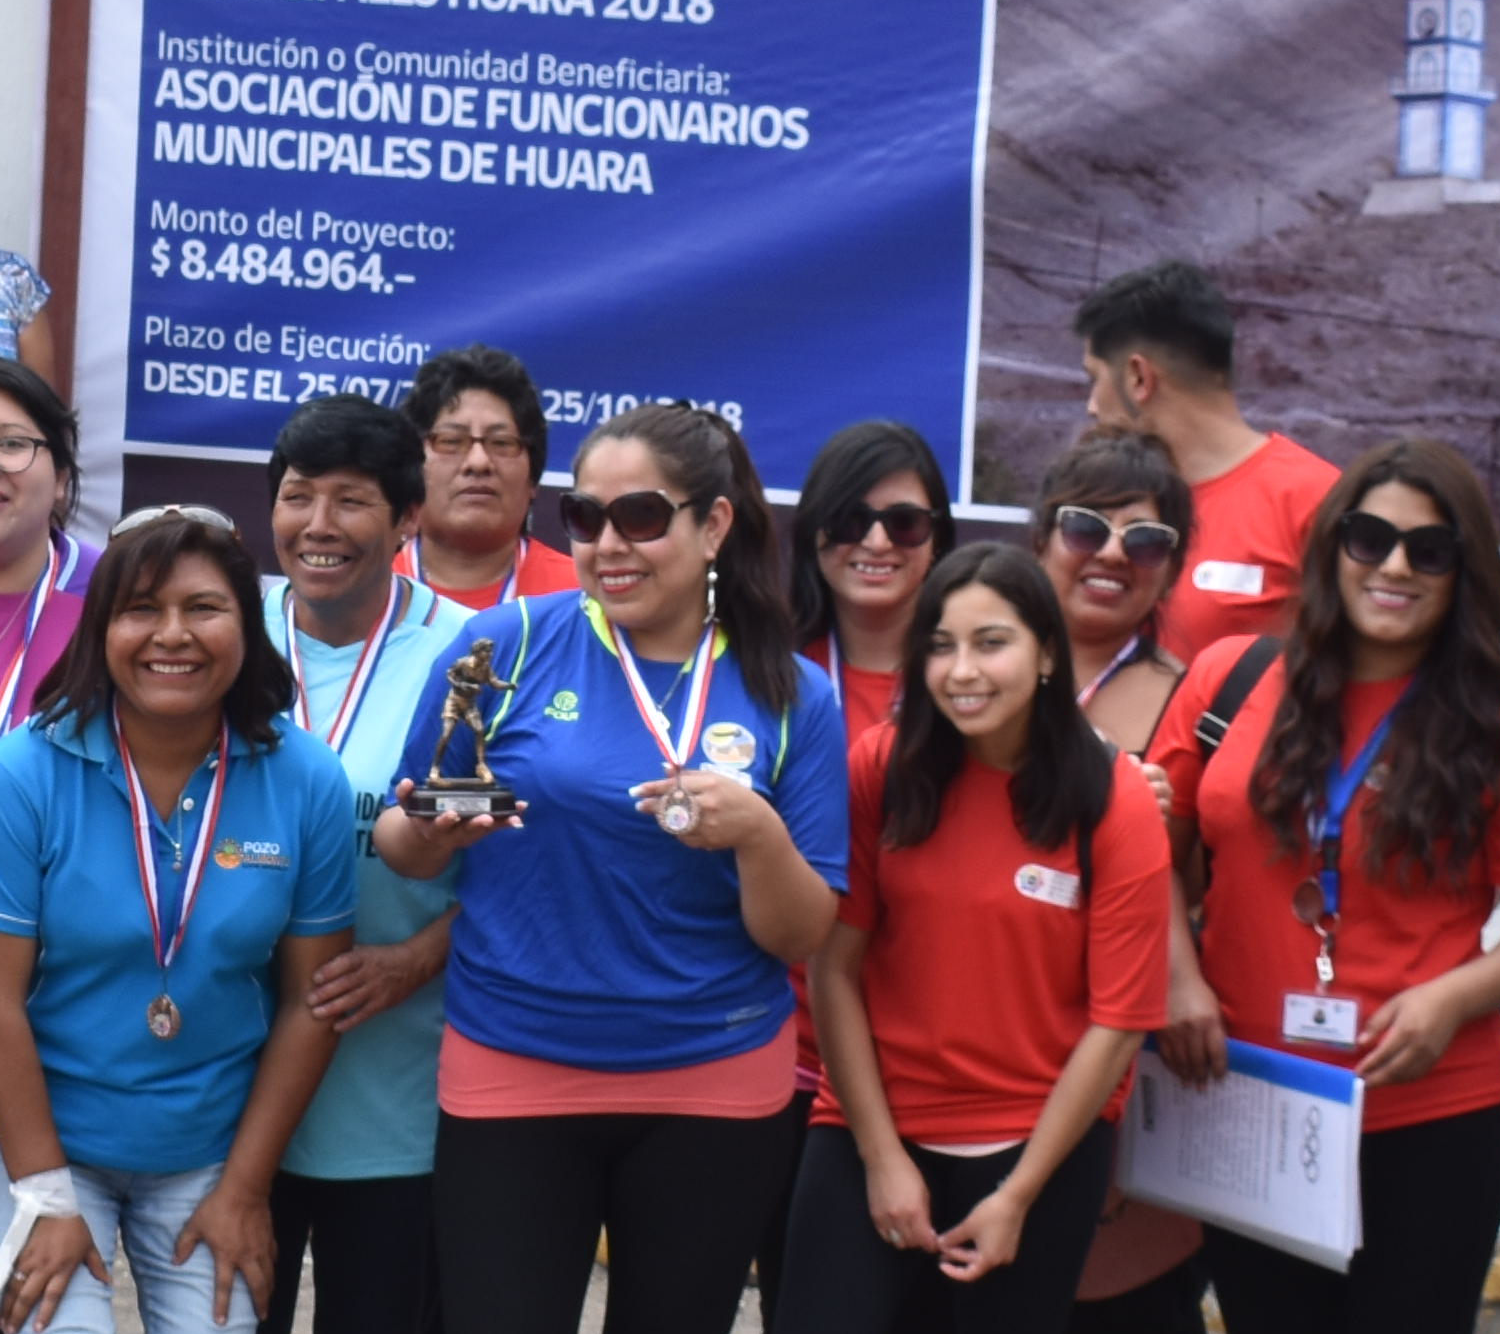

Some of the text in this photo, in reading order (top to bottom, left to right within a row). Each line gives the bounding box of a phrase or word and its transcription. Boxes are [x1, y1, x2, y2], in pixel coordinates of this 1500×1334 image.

[157, 30, 730, 95] Institución o Comunidad Beneficiaria:
[155, 67, 810, 151] ASOCIACIÓN DE FUNCIONARIOS
[153, 122, 653, 195] MUNICIPALES DE HUARA
[151, 201, 455, 255] Monto del Proyecto:
[150, 238, 415, 294] $ 8.484.964.-
[145, 315, 225, 351] Plazo
[234, 320, 272, 354] de
[144, 361, 248, 399] DESDE
[253, 369, 291, 403] EL
[243, 841, 281, 855] POZO
